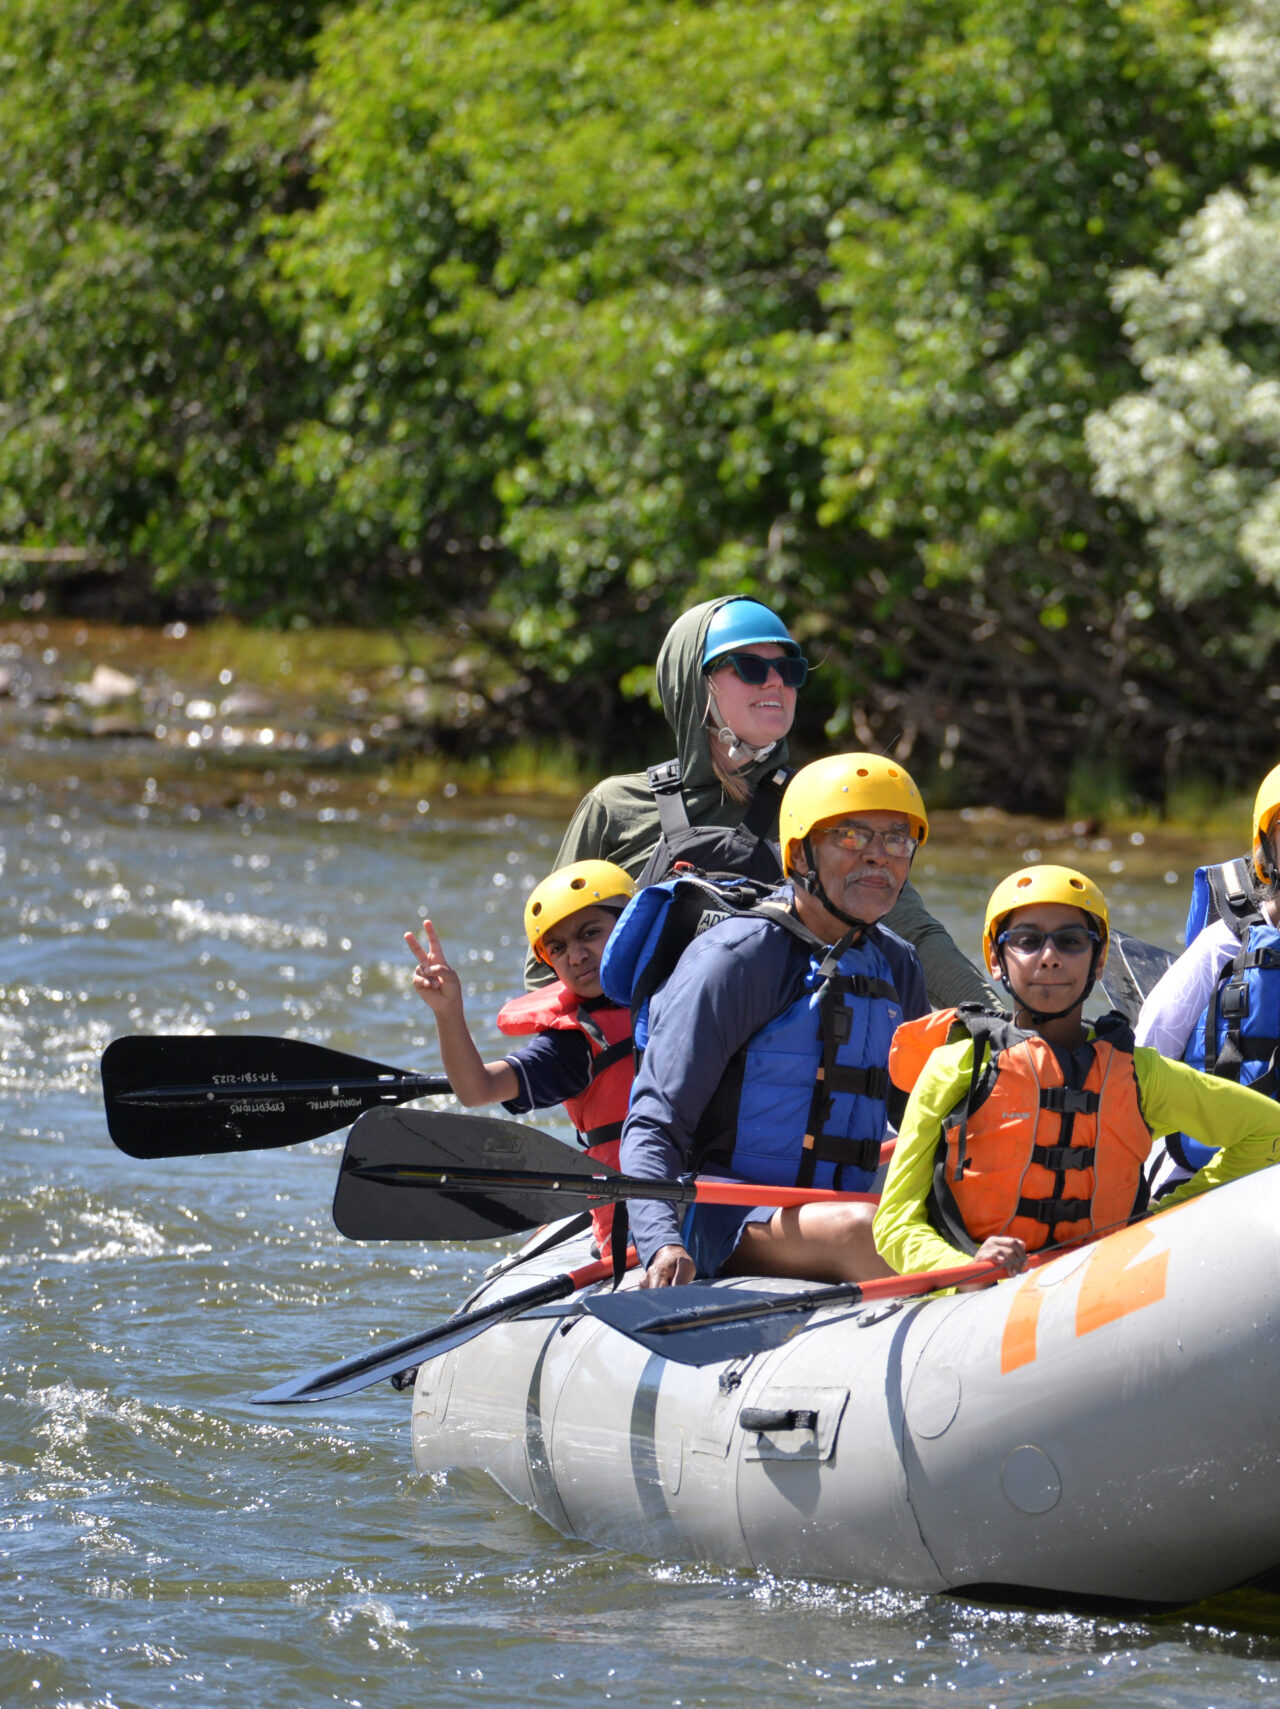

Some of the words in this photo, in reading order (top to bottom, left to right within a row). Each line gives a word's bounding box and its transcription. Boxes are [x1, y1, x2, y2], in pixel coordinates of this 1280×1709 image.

[212, 1072, 278, 1085] 719-581-2123
[230, 1101, 286, 1115] EXPEDITIONS
[306, 1098, 362, 1111] MONUMENTAL
[1001, 1111, 1031, 1120] NRS
